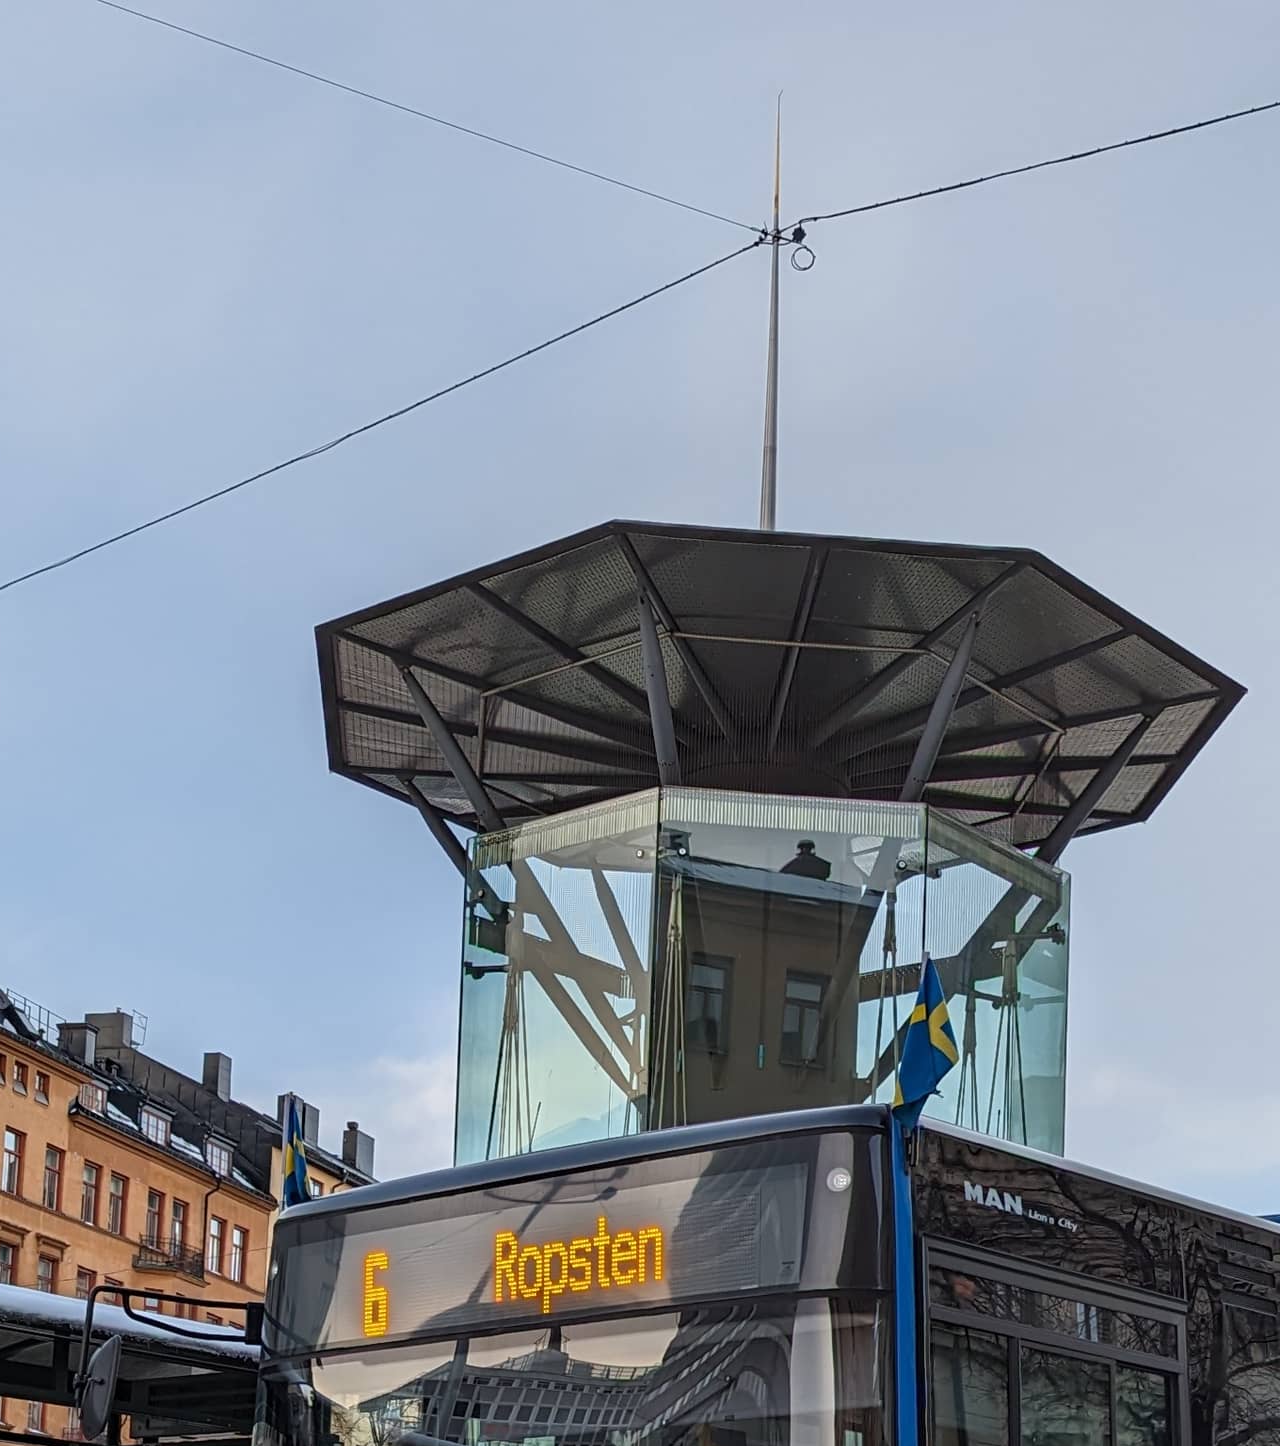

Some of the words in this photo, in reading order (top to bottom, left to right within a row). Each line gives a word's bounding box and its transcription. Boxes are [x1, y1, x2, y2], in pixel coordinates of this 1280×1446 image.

[963, 1180, 1023, 1216] MAN
[1057, 1217, 1078, 1233] City
[363, 1251, 389, 1338] 6
[494, 1215, 663, 1314] Ropsten
